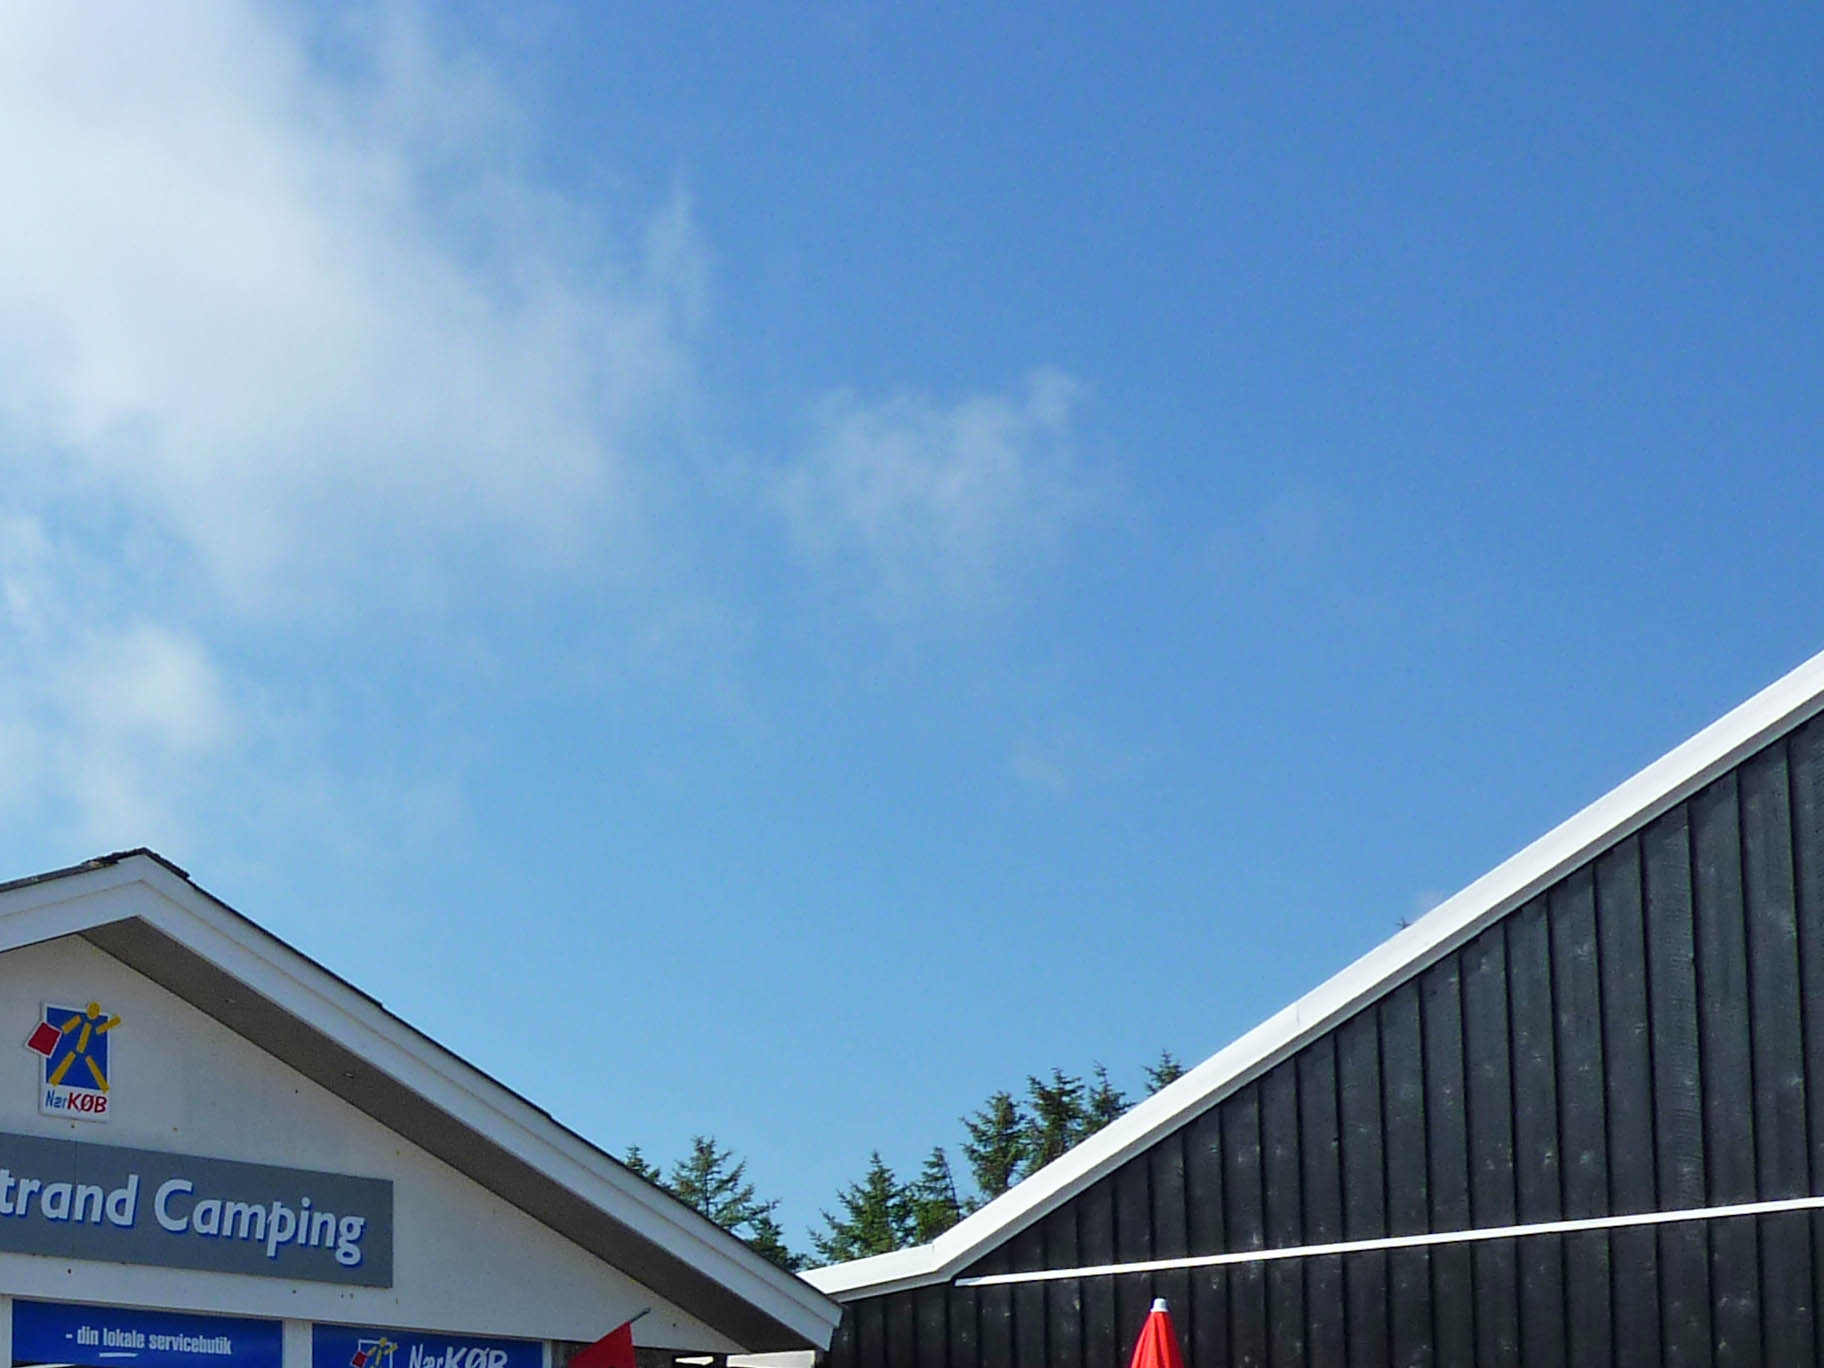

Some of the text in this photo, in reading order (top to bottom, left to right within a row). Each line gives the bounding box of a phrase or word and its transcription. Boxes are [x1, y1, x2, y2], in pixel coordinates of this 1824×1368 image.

[46, 1090, 108, 1113] NærKØB
[154, 1179, 367, 1266] Camping
[77, 1326, 99, 1346] din
[103, 1327, 145, 1349] lokale
[149, 1333, 233, 1355] servicebutik
